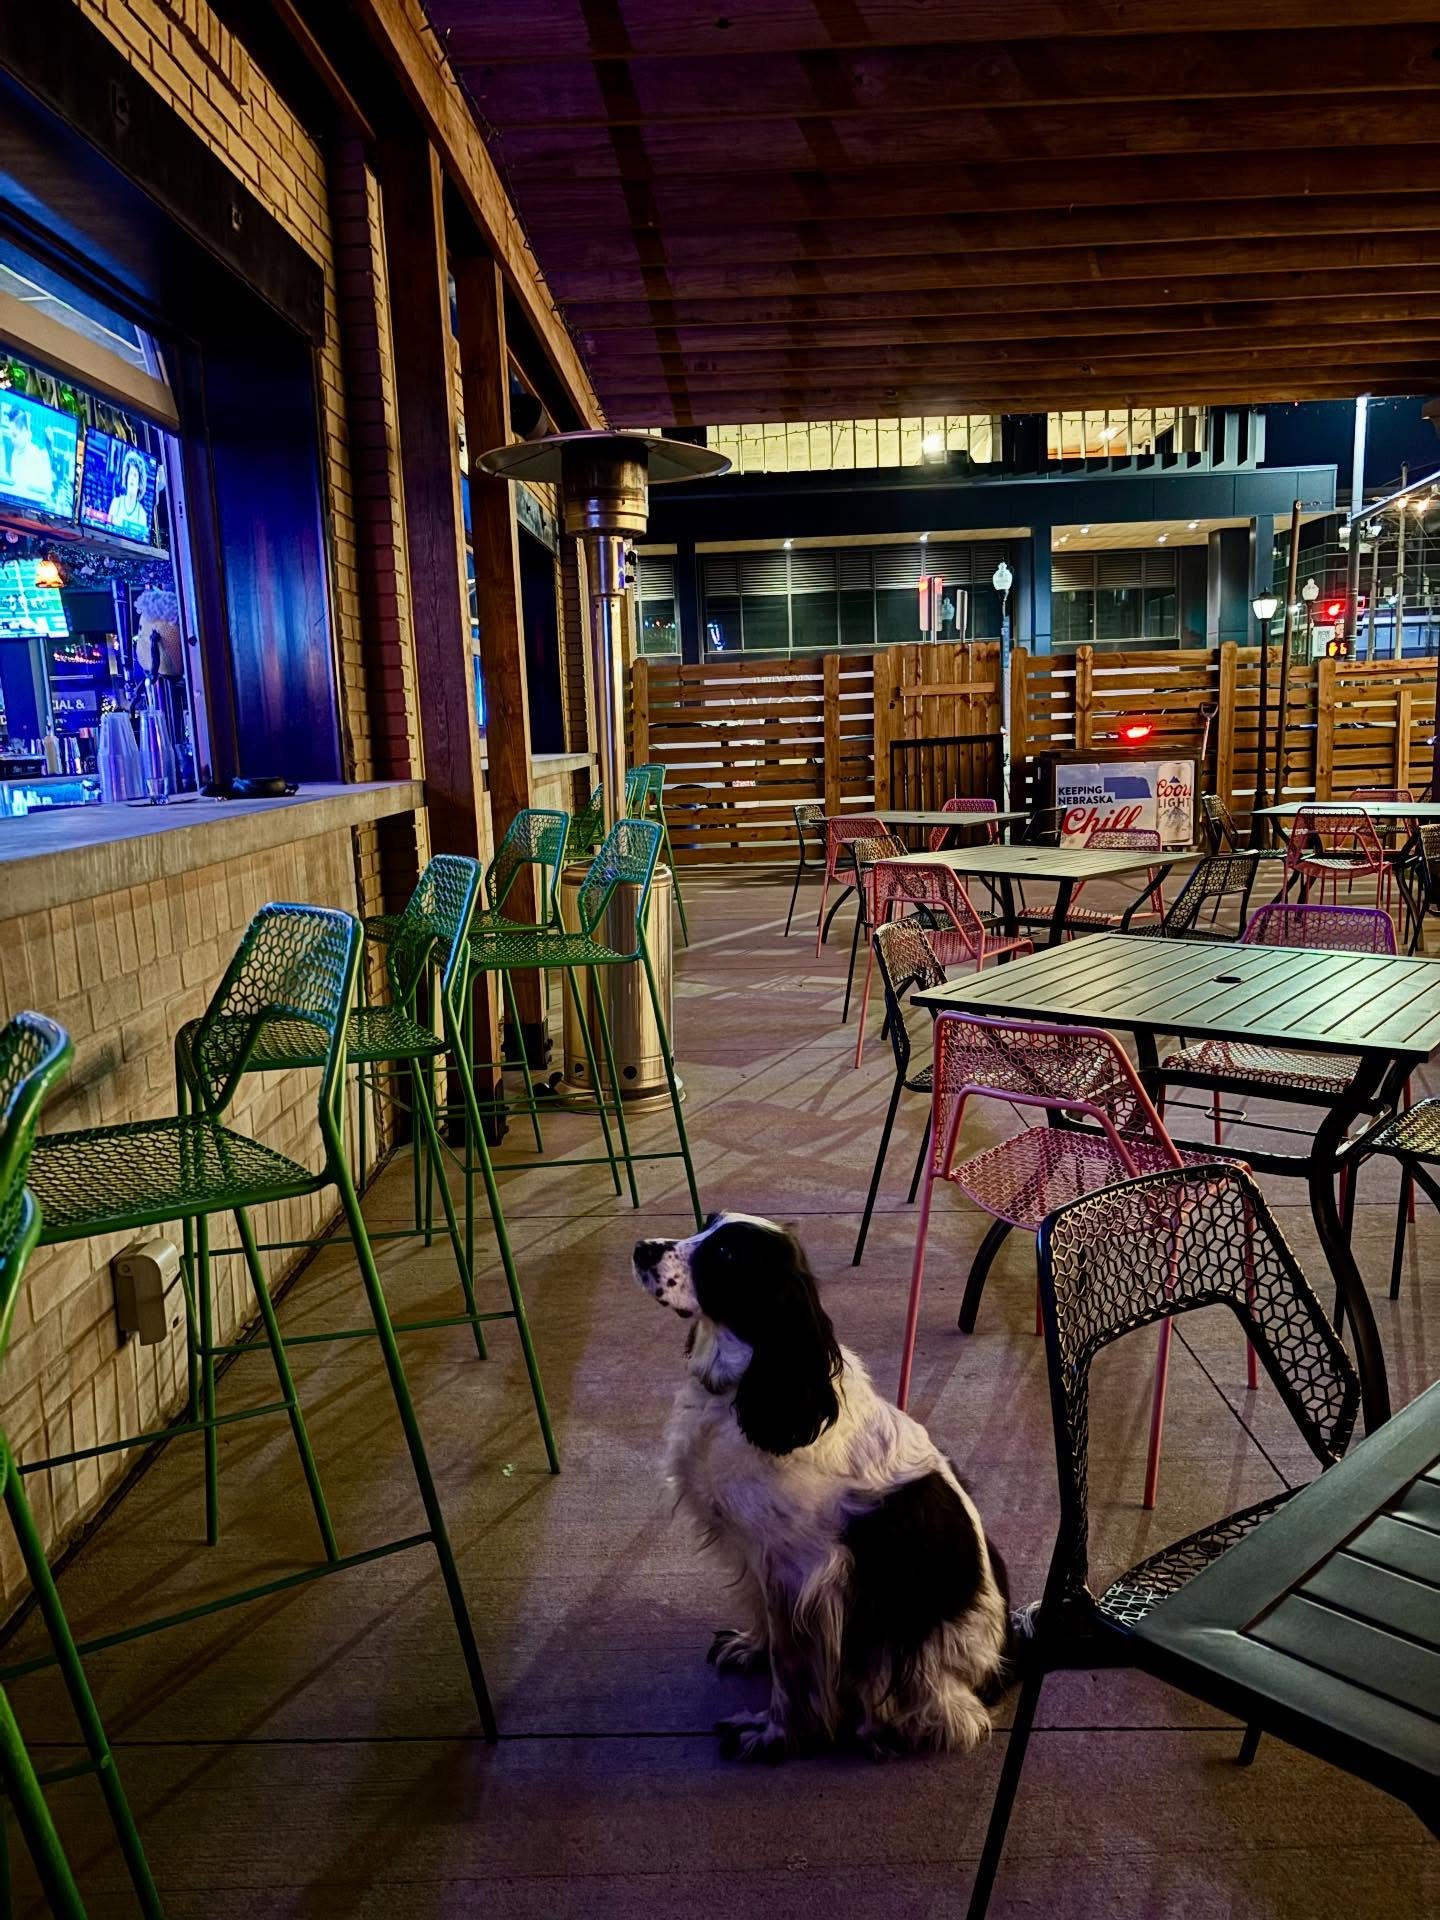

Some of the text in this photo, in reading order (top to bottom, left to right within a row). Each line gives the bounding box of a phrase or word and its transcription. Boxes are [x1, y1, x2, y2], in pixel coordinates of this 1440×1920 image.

[1058, 785, 1102, 796] KEEPING
[1058, 795, 1114, 805] NEBRASKA
[1158, 798, 1190, 808] LIGHT
[1062, 805, 1143, 835] Chill
